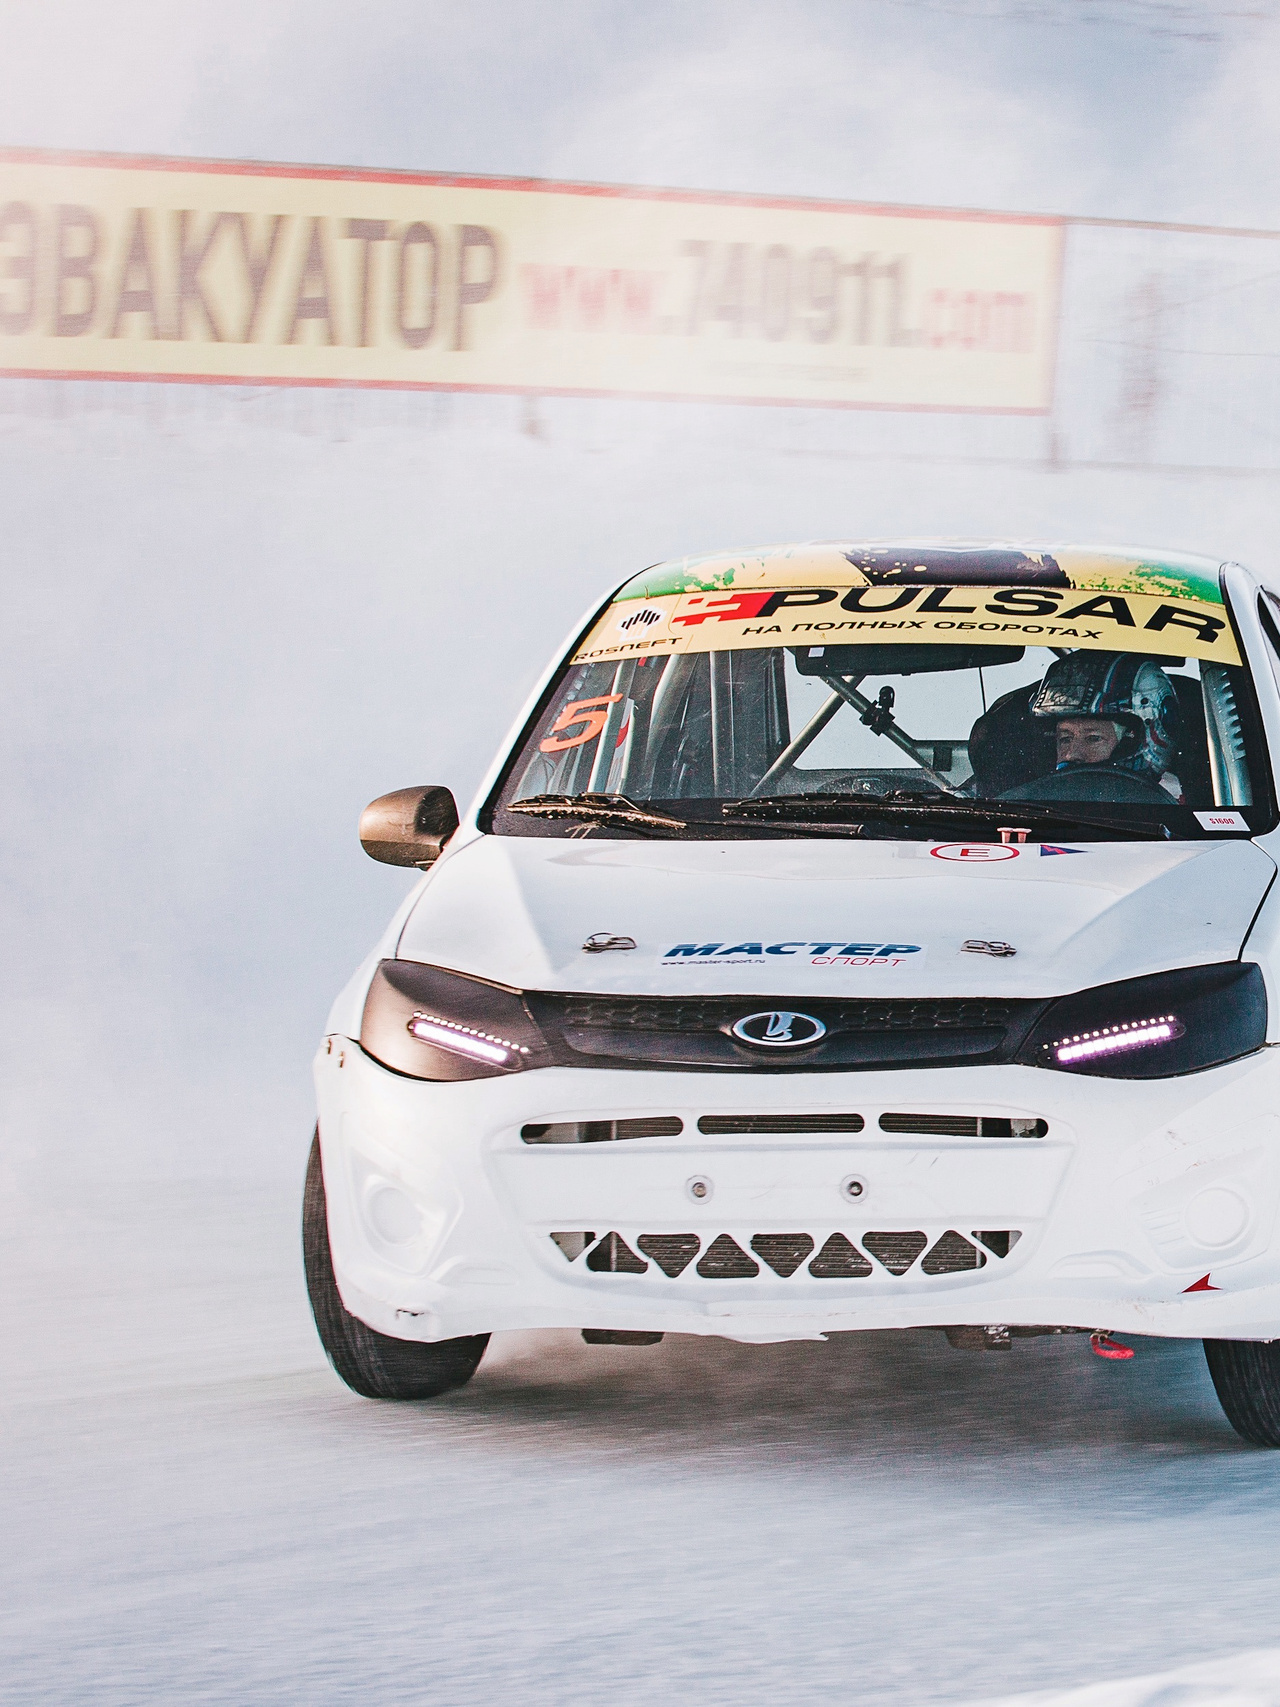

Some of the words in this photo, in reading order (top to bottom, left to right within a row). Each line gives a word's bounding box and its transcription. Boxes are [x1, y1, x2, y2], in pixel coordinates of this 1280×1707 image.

[0, 200, 500, 352] ЭВАКУАТОР
[756, 587, 1228, 644] PULSAR
[742, 624, 781, 636] НА
[791, 620, 928, 633] ПОЛНЫХ
[933, 620, 1104, 640] ОБОРОТАХ
[960, 848, 990, 857] E
[664, 942, 922, 957] МАСТЕР
[811, 956, 907, 967] СПОРТ
